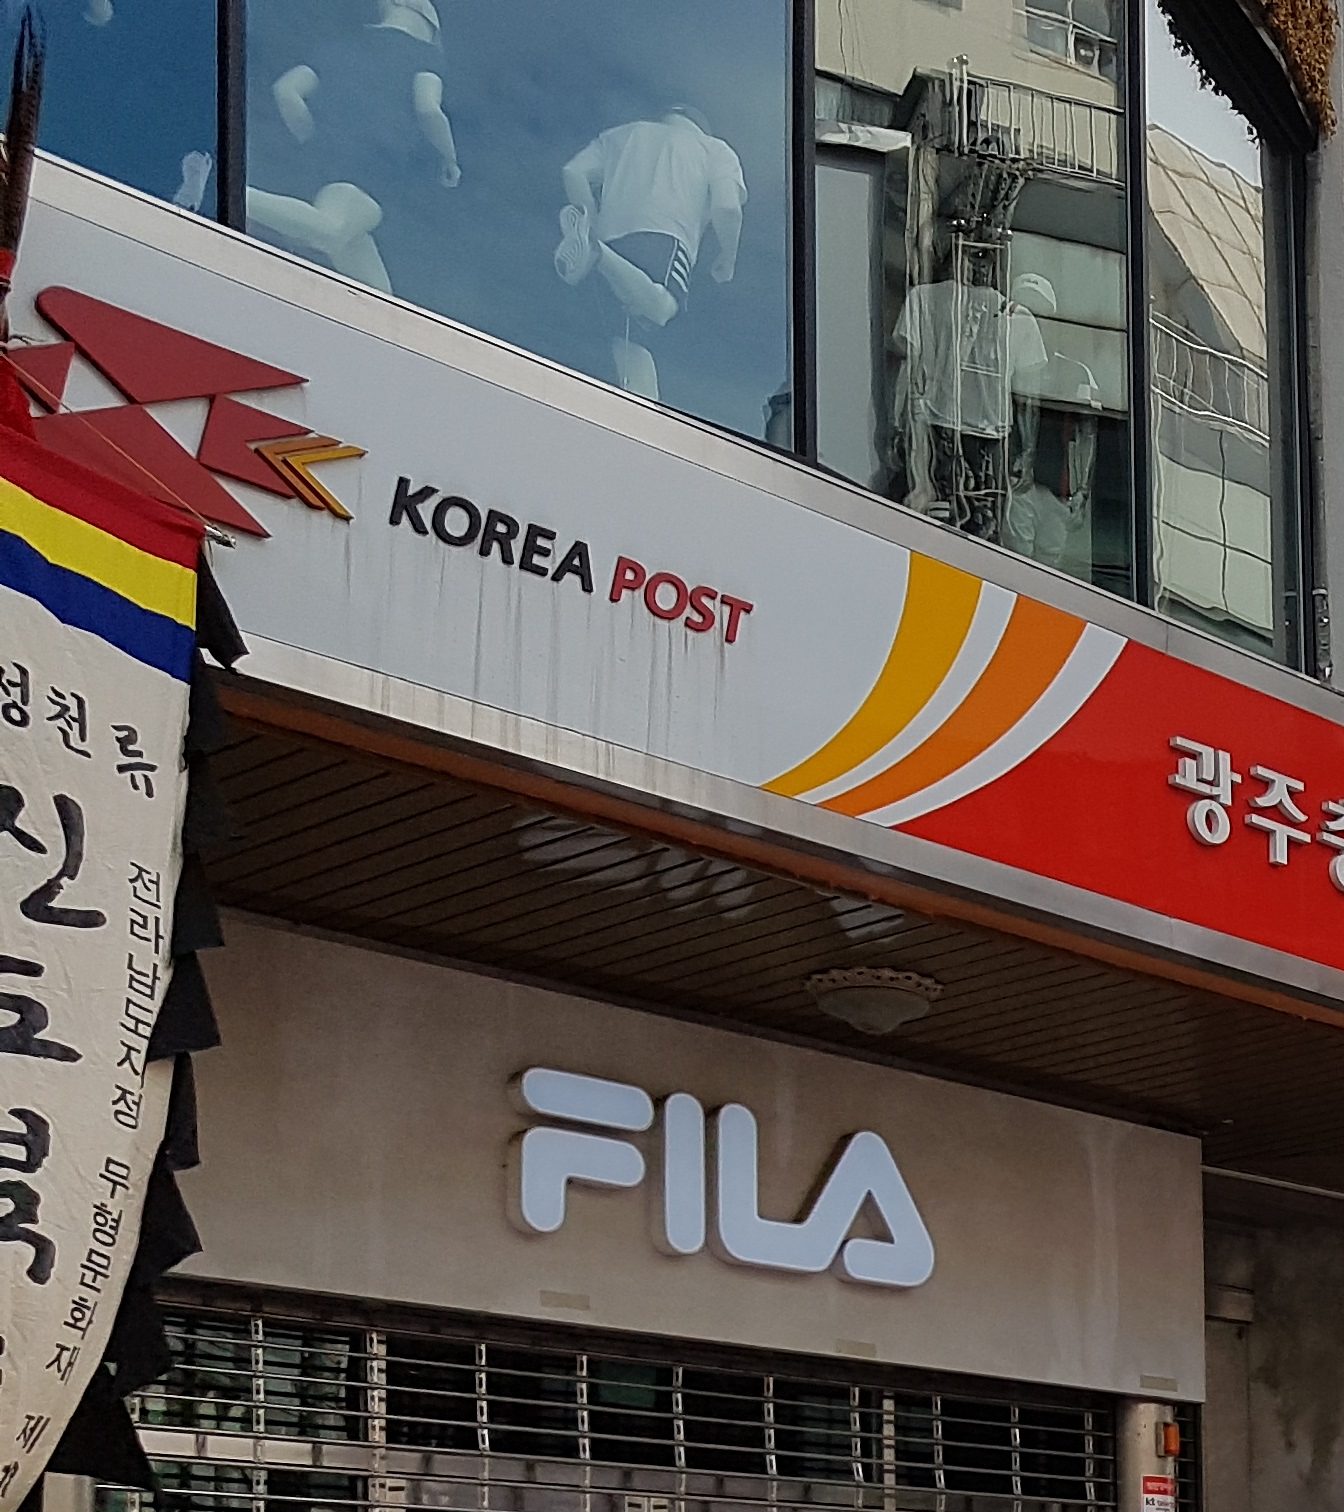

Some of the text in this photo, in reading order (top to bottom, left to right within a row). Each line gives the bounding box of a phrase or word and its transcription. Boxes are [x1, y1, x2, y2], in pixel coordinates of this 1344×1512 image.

[389, 476, 754, 644] KOREA POST
[521, 1067, 935, 1287] FILA
